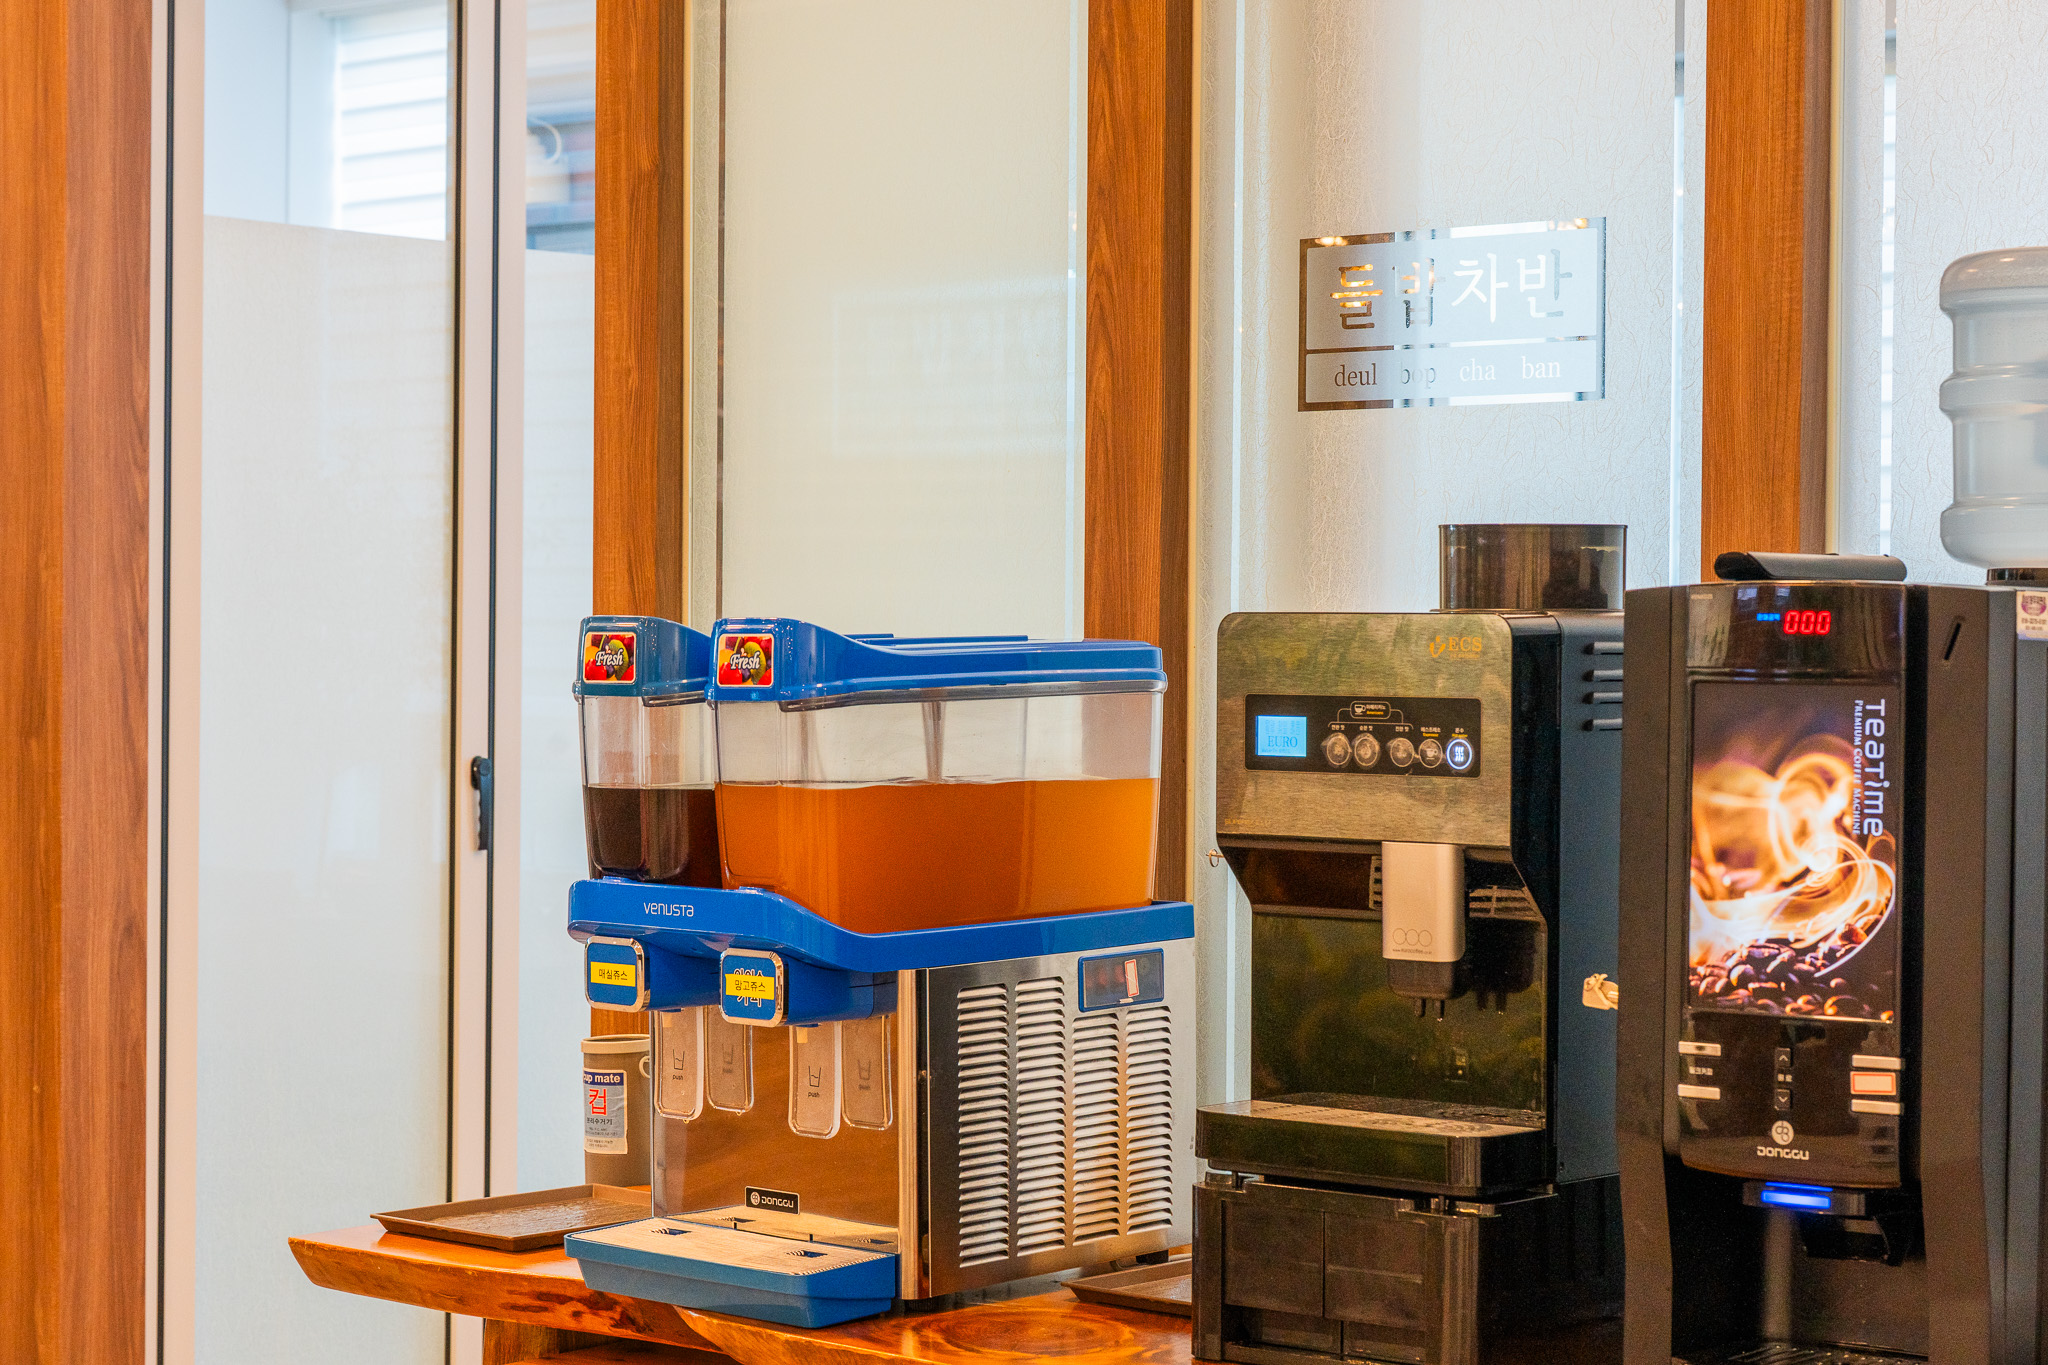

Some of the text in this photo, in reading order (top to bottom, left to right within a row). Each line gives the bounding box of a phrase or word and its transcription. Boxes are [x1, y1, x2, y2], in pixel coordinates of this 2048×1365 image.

[1334, 363, 1377, 387] deul
[1459, 358, 1496, 381] cha
[1522, 356, 1561, 379] ban
[1783, 610, 1831, 635] 000
[1448, 637, 1482, 652] ECS
[595, 648, 624, 666] Fresh
[730, 651, 761, 670] Fresh
[1267, 735, 1298, 748] EURO
[1852, 700, 1863, 835] PREMIUM COFFEE MACHINE
[598, 968, 628, 981] 매실쥬스
[734, 979, 766, 992] 망고쥬스
[595, 1074, 620, 1083] mate
[589, 1088, 606, 1115] 컵
